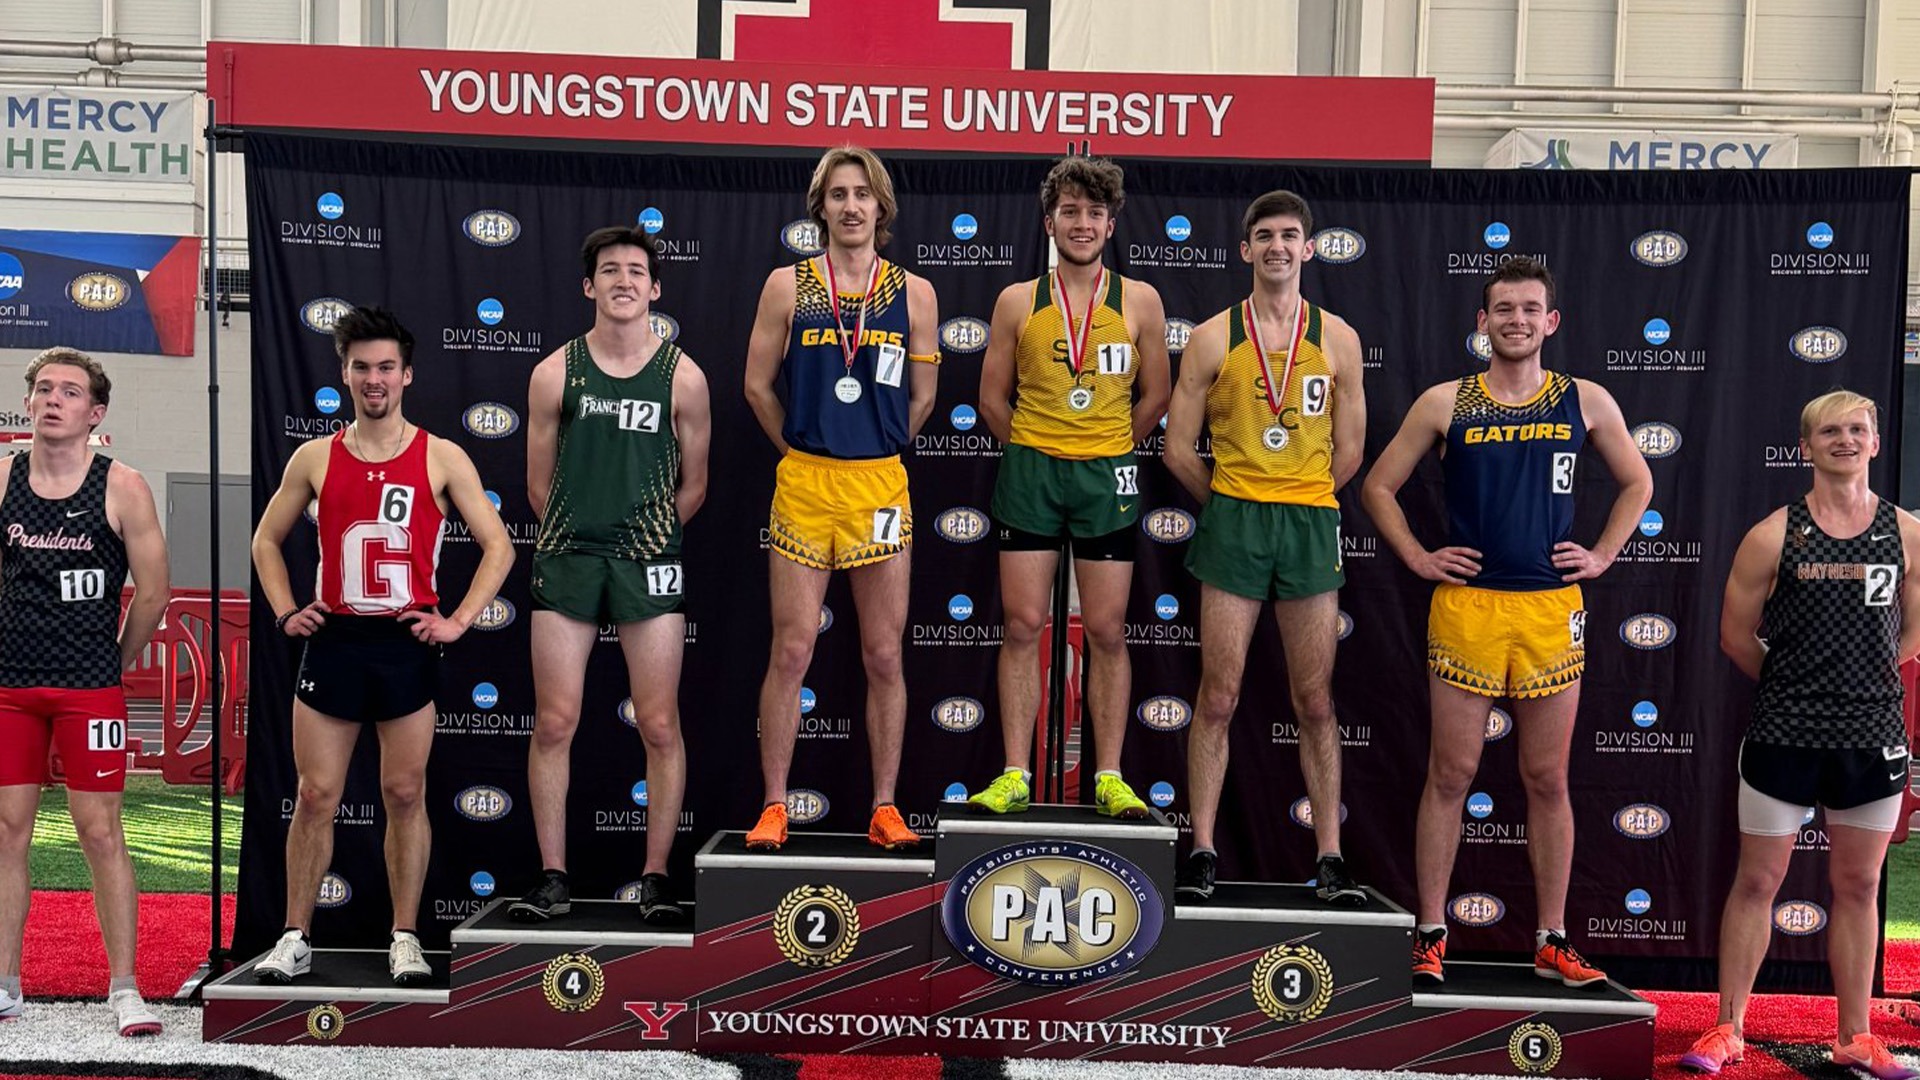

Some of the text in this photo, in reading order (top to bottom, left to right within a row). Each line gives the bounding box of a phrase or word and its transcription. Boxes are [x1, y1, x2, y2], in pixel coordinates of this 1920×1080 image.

[420, 69, 1234, 137] YOUNGSTOWN STATE UNIVERSITY
[7, 97, 168, 133] MERCY
[6, 138, 188, 175] HEALTH
[1608, 140, 1772, 169] MERCY
[320, 204, 344, 214] NCAA
[282, 222, 381, 242] DIVISION III
[476, 221, 509, 237] PAC
[955, 226, 977, 234] NCAA
[1168, 227, 1192, 236] NCAA
[1486, 234, 1510, 243] NCAA
[1810, 234, 1833, 242] NCAA
[687, 240, 700, 254] III
[918, 245, 1013, 259] DIVISION III
[1130, 244, 1226, 262] DIVISION III
[1321, 238, 1356, 254] PAC
[1643, 242, 1676, 257] PAC
[1771, 254, 1870, 268] DIVISION III
[0, 274, 22, 288] CAA
[80, 284, 116, 300] PAC
[480, 310, 502, 319] NCAA
[443, 328, 541, 346] DIVISION III
[949, 328, 982, 343] PAC
[1165, 328, 1190, 345] AC
[1646, 330, 1670, 339] NCAA
[1802, 338, 1835, 352] PAC
[1101, 345, 1126, 372] 11
[1369, 348, 1382, 360] III
[1608, 350, 1706, 365] DIVISION III
[883, 347, 902, 381] 7
[317, 398, 340, 407] NCAA
[1307, 378, 1326, 412] 9
[580, 394, 622, 420] FRANCI
[0, 411, 31, 427] Site
[474, 413, 506, 428] PAC
[624, 402, 655, 430] 12
[954, 414, 976, 424] NCAA
[1465, 423, 1572, 445] GATORS
[1638, 433, 1672, 449] PAC
[916, 436, 992, 450] DIVISION
[1766, 446, 1800, 460] DIVI
[1117, 467, 1136, 493] 11
[1557, 456, 1572, 490] 3
[383, 488, 408, 522] 6
[526, 524, 538, 536] III
[877, 508, 897, 540] 7
[947, 518, 978, 533] PAC
[1153, 518, 1184, 534] PAC
[1641, 520, 1663, 530] NCAA
[7, 523, 94, 551] Presidents
[1364, 537, 1376, 550] III
[1622, 541, 1700, 556] VISION III
[341, 520, 414, 616] G
[64, 570, 98, 599] 10
[650, 567, 678, 594] 12
[1870, 568, 1892, 602] 2
[482, 607, 503, 620] AC
[951, 605, 973, 614] NCAA
[1157, 606, 1180, 614] NCAA
[914, 624, 1004, 640] DIVISION III
[1632, 625, 1665, 640] PAC
[475, 694, 498, 702] NCAA
[801, 698, 816, 706] CAA
[436, 713, 534, 728] DIVISION III
[944, 706, 974, 722] PAC
[1150, 706, 1181, 722] PAC
[1634, 713, 1657, 722] NCAA
[838, 718, 850, 732] III
[92, 720, 121, 748] 10
[1357, 726, 1370, 740] III
[1596, 731, 1694, 746] DIVISION III
[466, 796, 500, 812] PAC
[1152, 792, 1175, 802] NCAA
[361, 804, 374, 818] III
[596, 811, 694, 824] DIVISI III
[1625, 814, 1658, 829] PAC
[1462, 823, 1509, 836] ISION
[961, 846, 1146, 902] PRESIDENTS' ATHLETIC
[320, 882, 342, 899] AC
[473, 882, 495, 891] NCAA
[1460, 904, 1492, 918] PAC
[1628, 900, 1650, 908] NCAA
[992, 884, 1116, 946] PAC
[1782, 912, 1814, 926] PAC
[807, 910, 826, 942] 2
[1588, 918, 1686, 934] DIVISION III
[986, 956, 1120, 982] CONFERENCE
[566, 972, 581, 994] 4
[1284, 969, 1301, 999] 3
[321, 1016, 330, 1029] 6
[624, 1002, 688, 1040] Y
[709, 1010, 1232, 1048] YOUNGSTOWN STATE UNIVERSITY
[1529, 1038, 1541, 1058] 5
